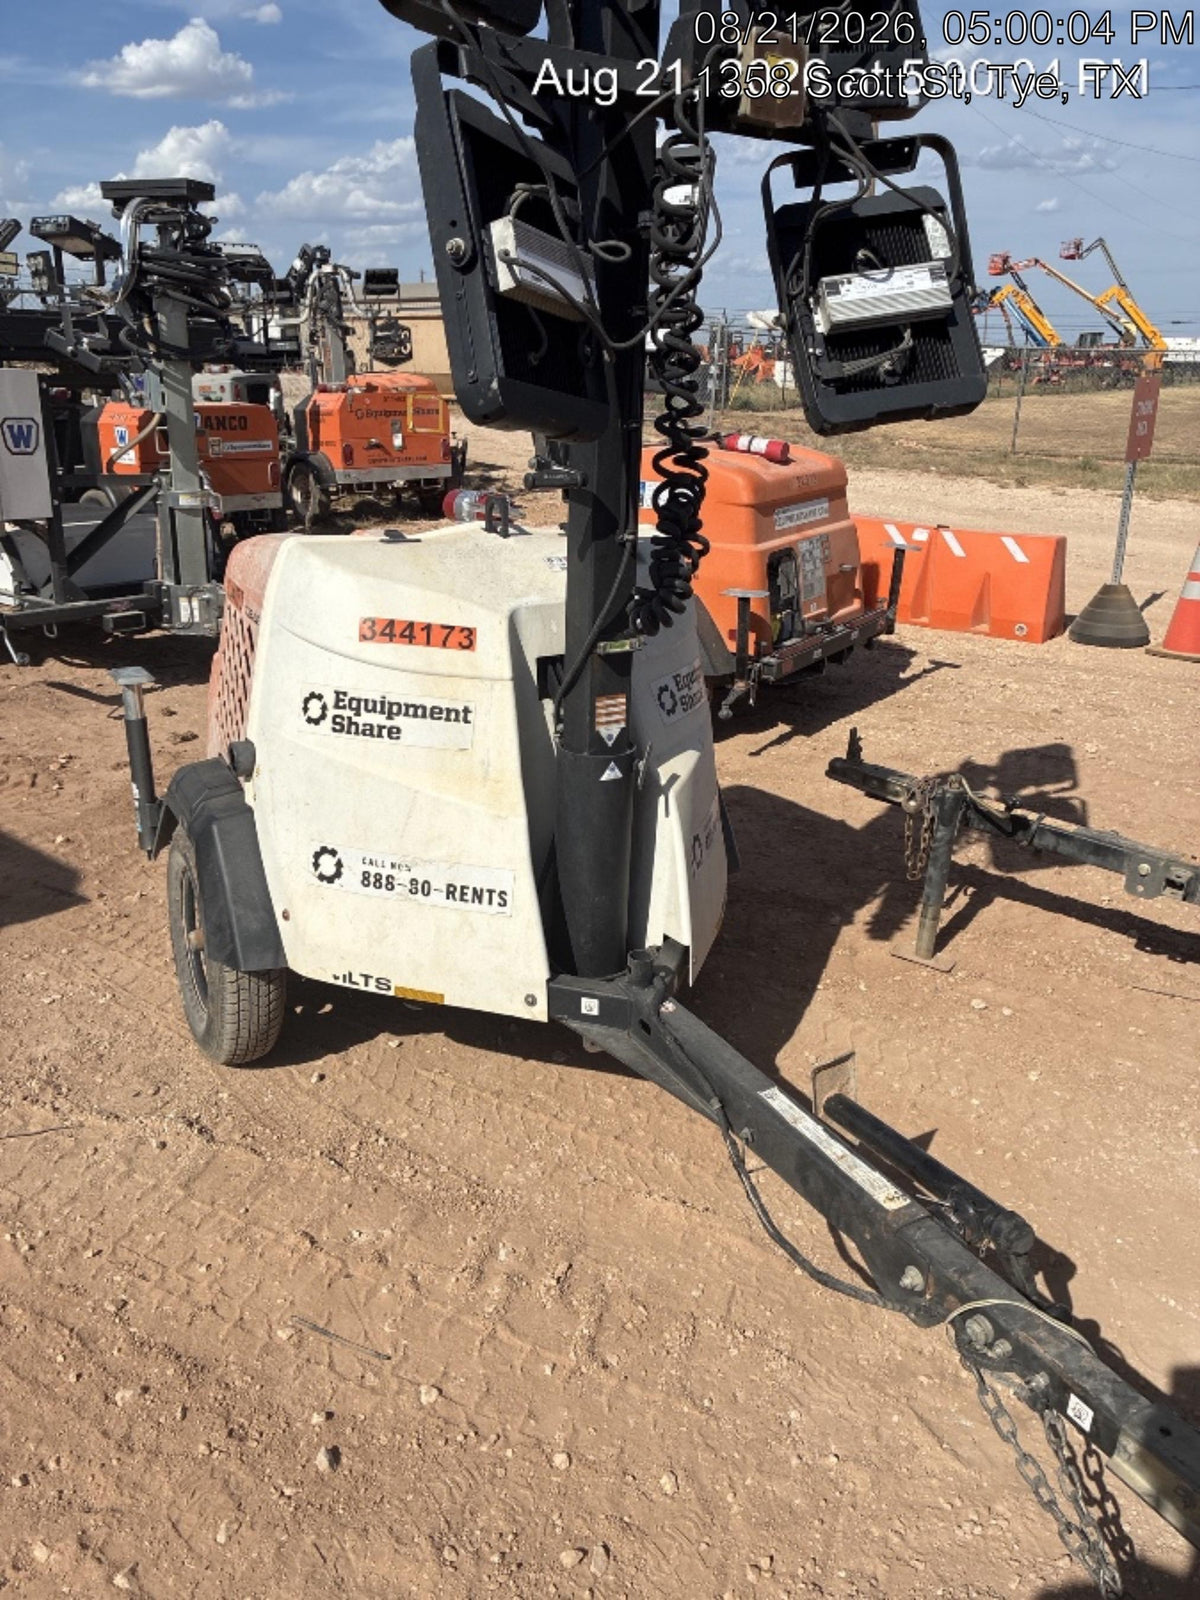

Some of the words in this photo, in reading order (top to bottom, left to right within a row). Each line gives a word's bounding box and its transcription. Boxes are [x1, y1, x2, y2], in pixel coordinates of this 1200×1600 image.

[6, 424, 34, 449] W
[360, 617, 475, 651] 344173
[332, 689, 473, 724] Equipment
[330, 714, 402, 741] Share
